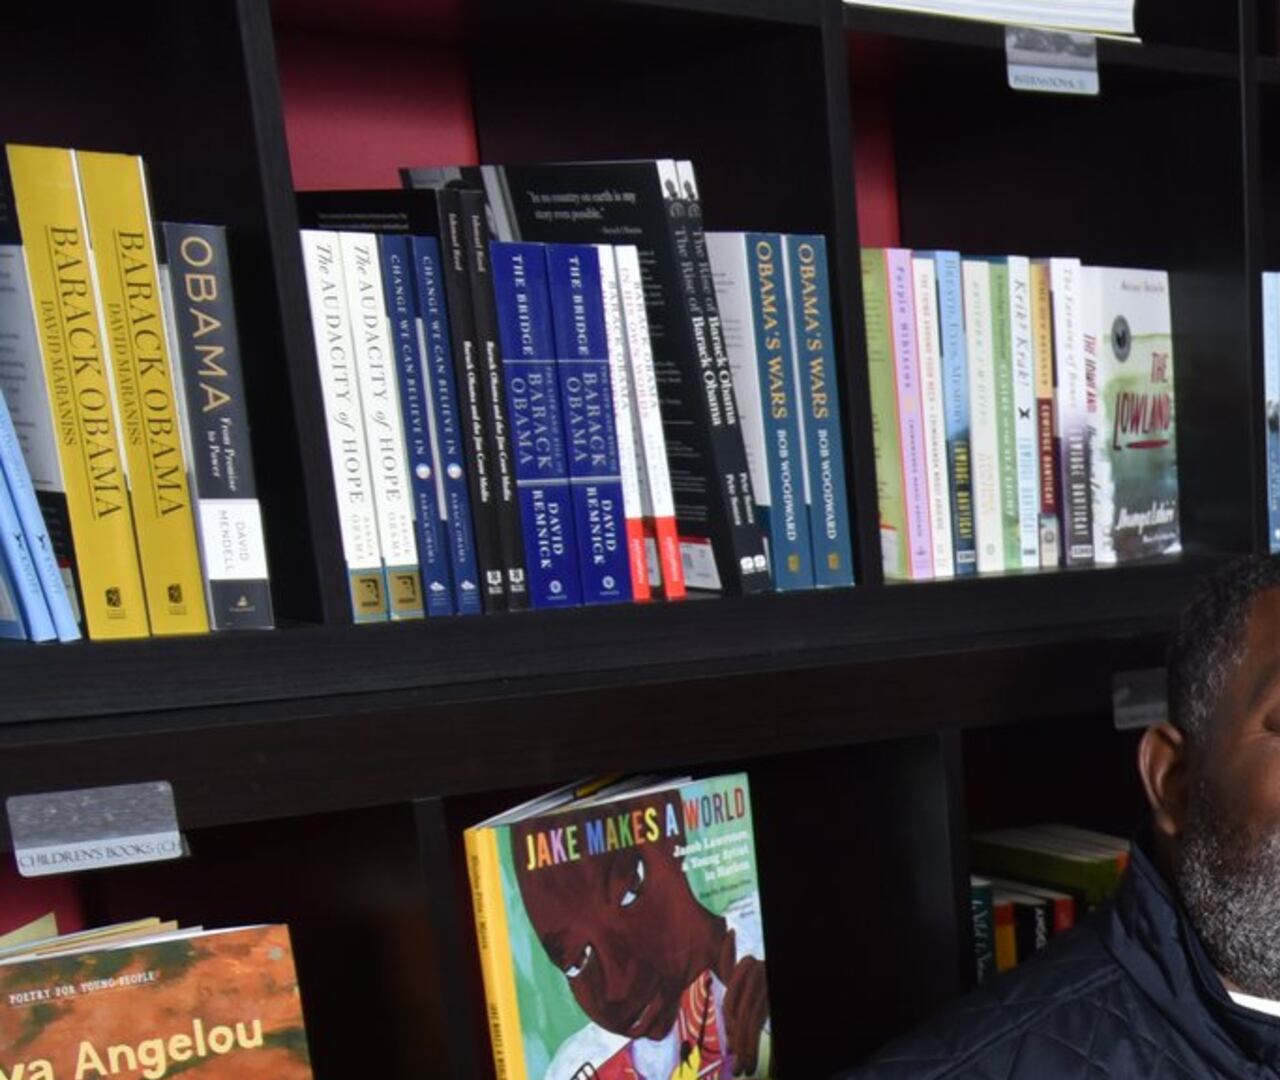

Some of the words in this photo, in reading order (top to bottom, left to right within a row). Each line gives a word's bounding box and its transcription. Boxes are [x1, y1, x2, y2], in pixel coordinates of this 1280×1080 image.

[315, 243, 334, 276] The
[354, 244, 370, 277] The
[390, 254, 407, 313] CHANGE
[512, 253, 525, 287] THE
[568, 255, 582, 288] THE
[180, 235, 232, 413] OBAMA
[515, 292, 535, 357] BRIDGE
[573, 294, 590, 357] BRIDGE
[755, 240, 781, 351] OBAMA'S
[797, 243, 823, 352] OBAMA'S
[51, 226, 100, 376] BARACK
[78, 386, 123, 519] OBAMA
[118, 228, 166, 375] BARACK
[142, 387, 185, 518] OBAMA
[321, 278, 352, 406] AUDACITY
[359, 280, 389, 404] AUDACITY
[402, 344, 415, 373] CAN
[691, 315, 713, 369] Barack
[703, 369, 722, 427] Obama
[406, 379, 422, 434] BELIEVE
[582, 371, 608, 468] BARACK
[766, 356, 788, 420] WARS
[808, 356, 829, 420] WARS
[207, 429, 216, 442] to
[219, 417, 232, 446] From
[333, 410, 356, 434] of
[370, 410, 393, 433] of
[511, 377, 534, 466] OBAMA
[527, 371, 553, 470] BARACK
[776, 429, 790, 458] BOB
[816, 429, 829, 458] BOB
[1112, 391, 1171, 451] LOWLAND
[209, 443, 222, 479] Power
[223, 448, 238, 493] Promise
[343, 439, 364, 504] HOPE
[380, 437, 401, 502] HOPE
[531, 489, 554, 571] REMNICK
[545, 501, 565, 557] DAVID
[585, 485, 607, 566] REMNICK
[599, 498, 618, 553] DAVID
[778, 459, 798, 542] WOODWARD
[820, 459, 839, 540] WOODWARD
[234, 520, 250, 562] DAVID
[20, 846, 102, 868] CHILDREN'S
[105, 841, 156, 859] BOOKS
[525, 825, 582, 872] JAKE
[584, 806, 660, 857] MAKES
[664, 802, 679, 838] A
[684, 786, 746, 831] WORLD
[54, 983, 76, 999] FOR
[79, 977, 116, 994] YOUNG
[118, 970, 156, 989] PEOPLE
[74, 1017, 265, 1080] Angelou
